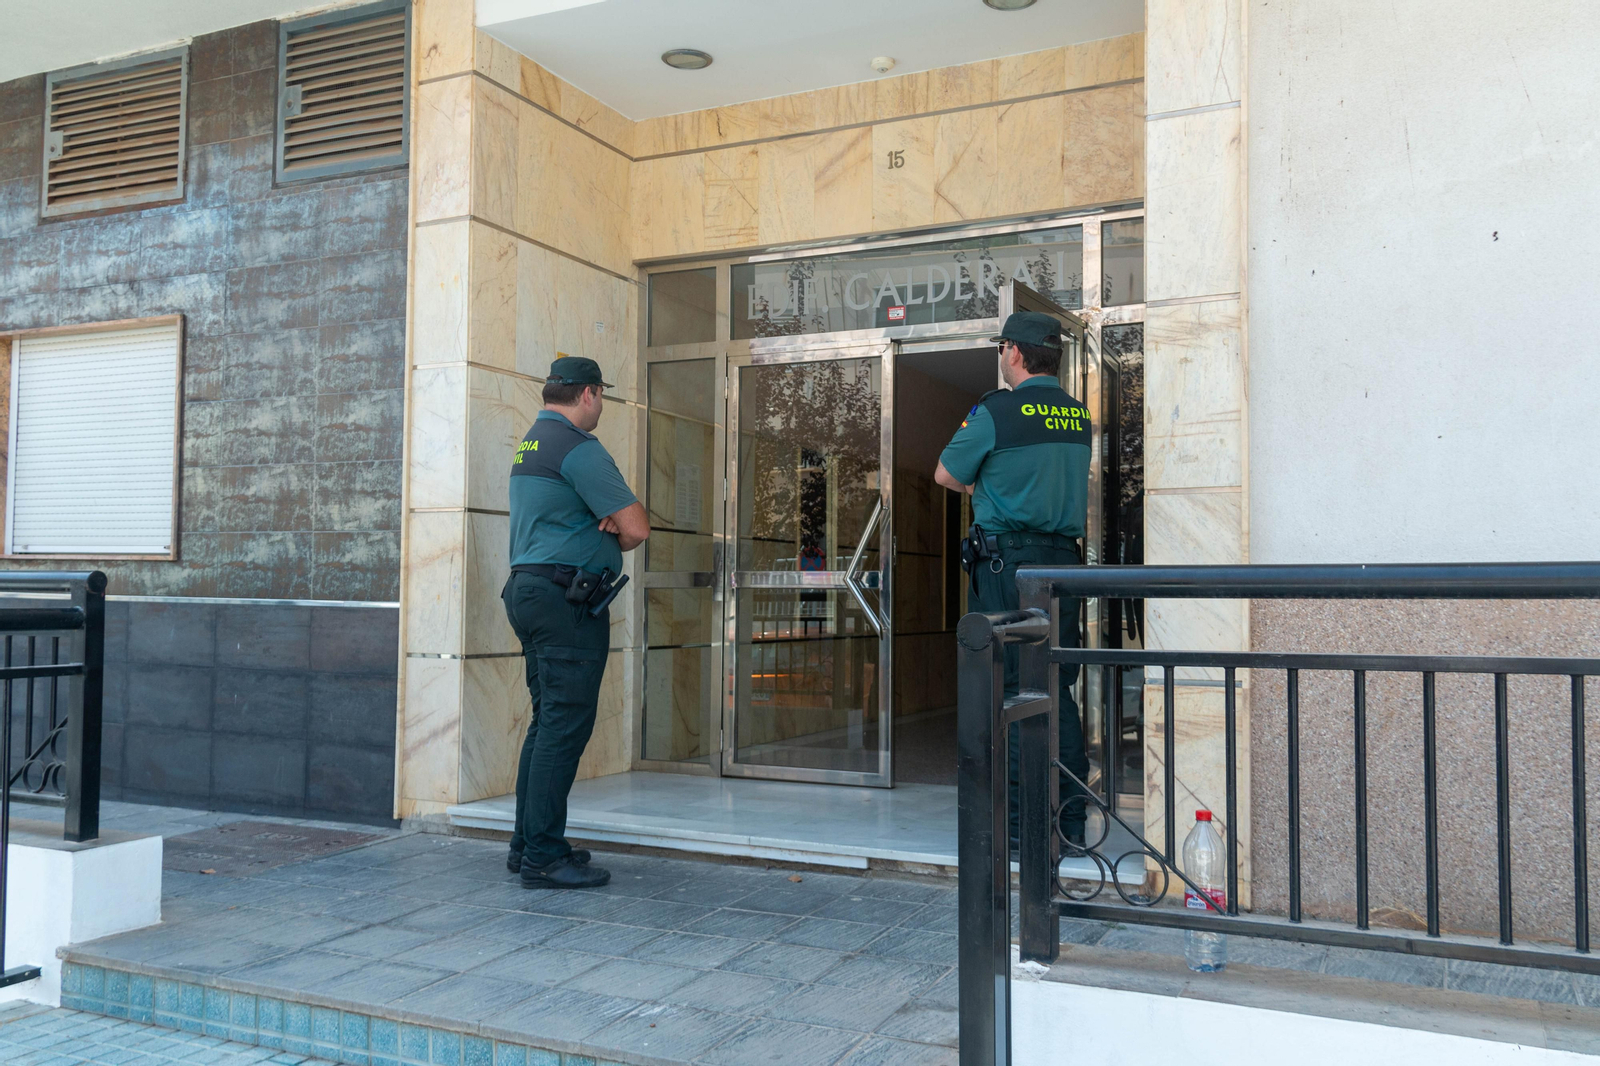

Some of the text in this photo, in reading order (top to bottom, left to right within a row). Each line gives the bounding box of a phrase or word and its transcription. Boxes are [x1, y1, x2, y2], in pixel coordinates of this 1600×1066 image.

[887, 149, 905, 169] 15
[747, 278, 829, 320] EDIF.
[844, 256, 1039, 310] CALDERA
[1021, 403, 1092, 420] GUARDIA
[1045, 417, 1083, 431] CIVIL
